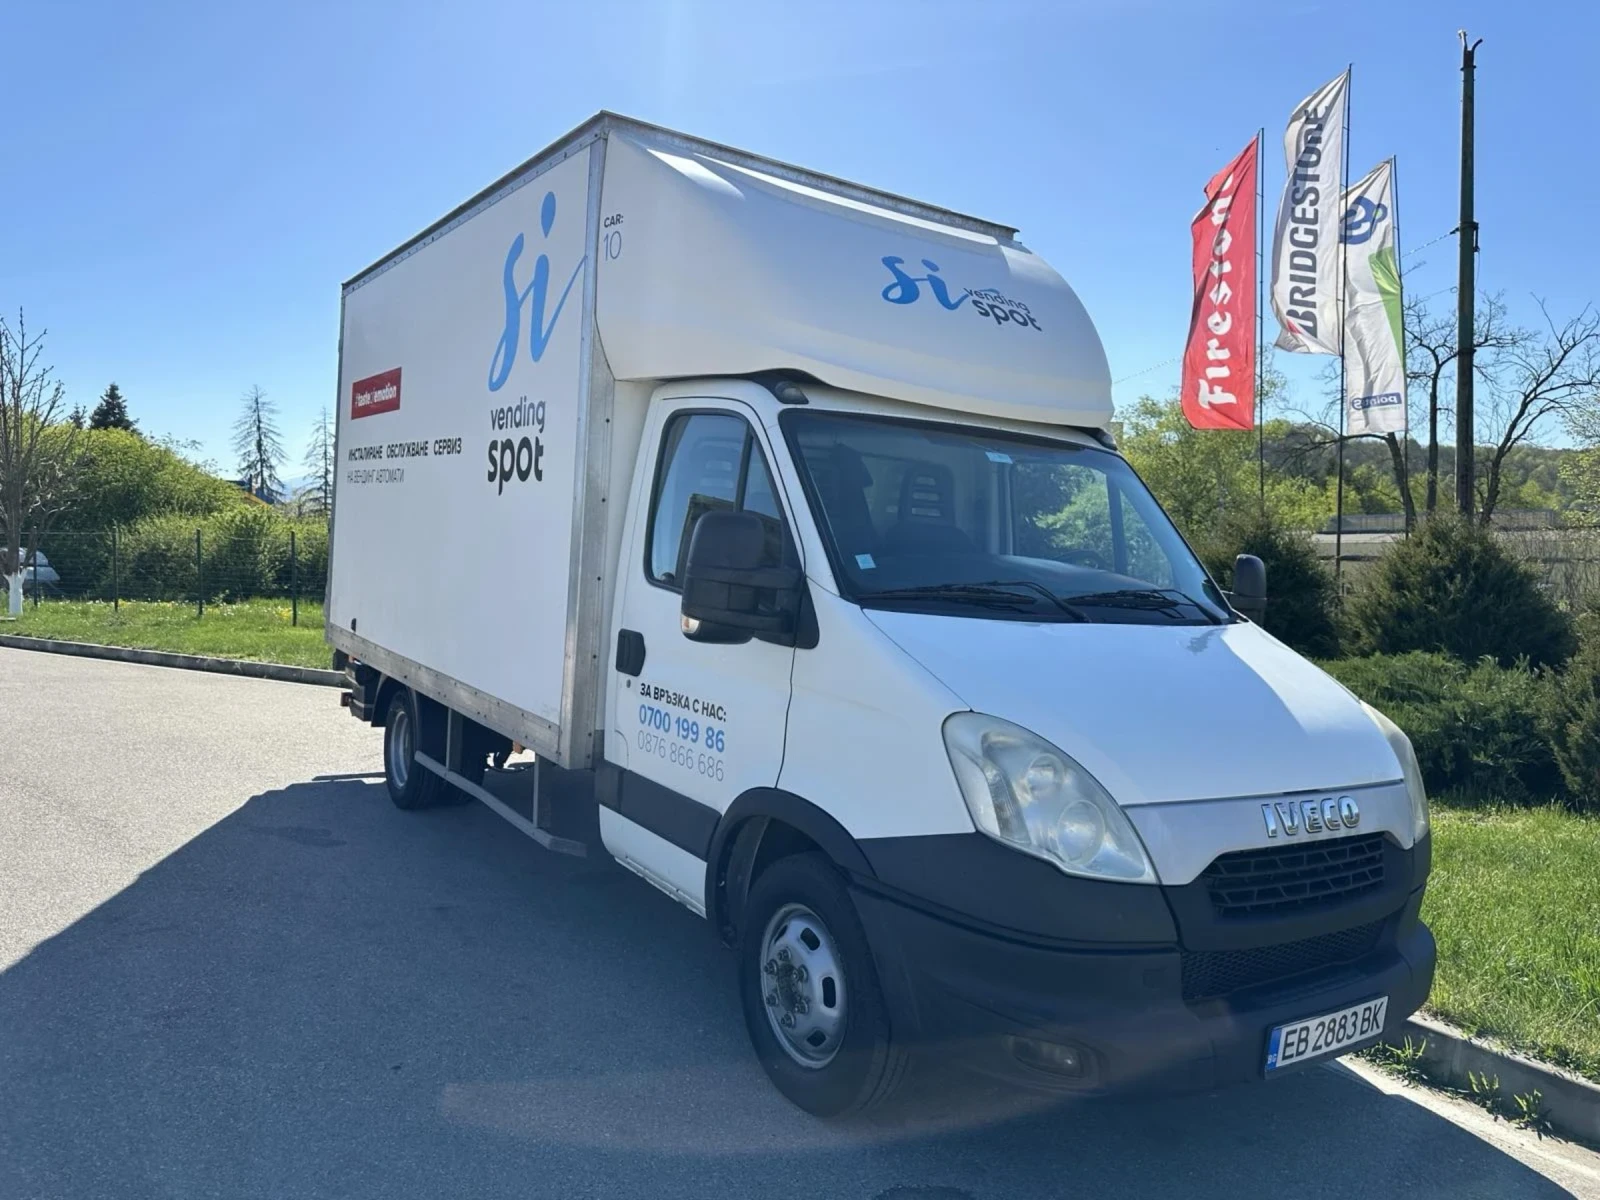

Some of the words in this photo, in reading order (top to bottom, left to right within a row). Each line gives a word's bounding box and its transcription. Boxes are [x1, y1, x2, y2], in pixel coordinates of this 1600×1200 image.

[603, 213, 624, 228] CAR:
[1286, 105, 1329, 338] BRIDGESTONE
[603, 230, 622, 261] 10
[963, 287, 1031, 314] vending
[972, 299, 1042, 332] spot
[490, 396, 546, 434] vending
[386, 440, 429, 459] ОБСЛУЖВАНЕ
[433, 437, 462, 456] СЕРВИЗ
[487, 436, 544, 496] spot
[640, 682, 652, 699] ЗА
[653, 686, 691, 711] ВРЪЗКА
[692, 698, 700, 713] С
[701, 700, 727, 722] НАС:
[639, 703, 671, 733] 0700
[675, 716, 699, 743] 199
[705, 726, 725, 753] 86
[637, 730, 666, 759] 0876
[669, 742, 694, 770] 866
[698, 753, 724, 782] 686
[1261, 795, 1361, 838] IVECO
[1281, 1025, 1310, 1061] EB
[1312, 1010, 1358, 1051] 2883
[1360, 1002, 1384, 1034] BK
